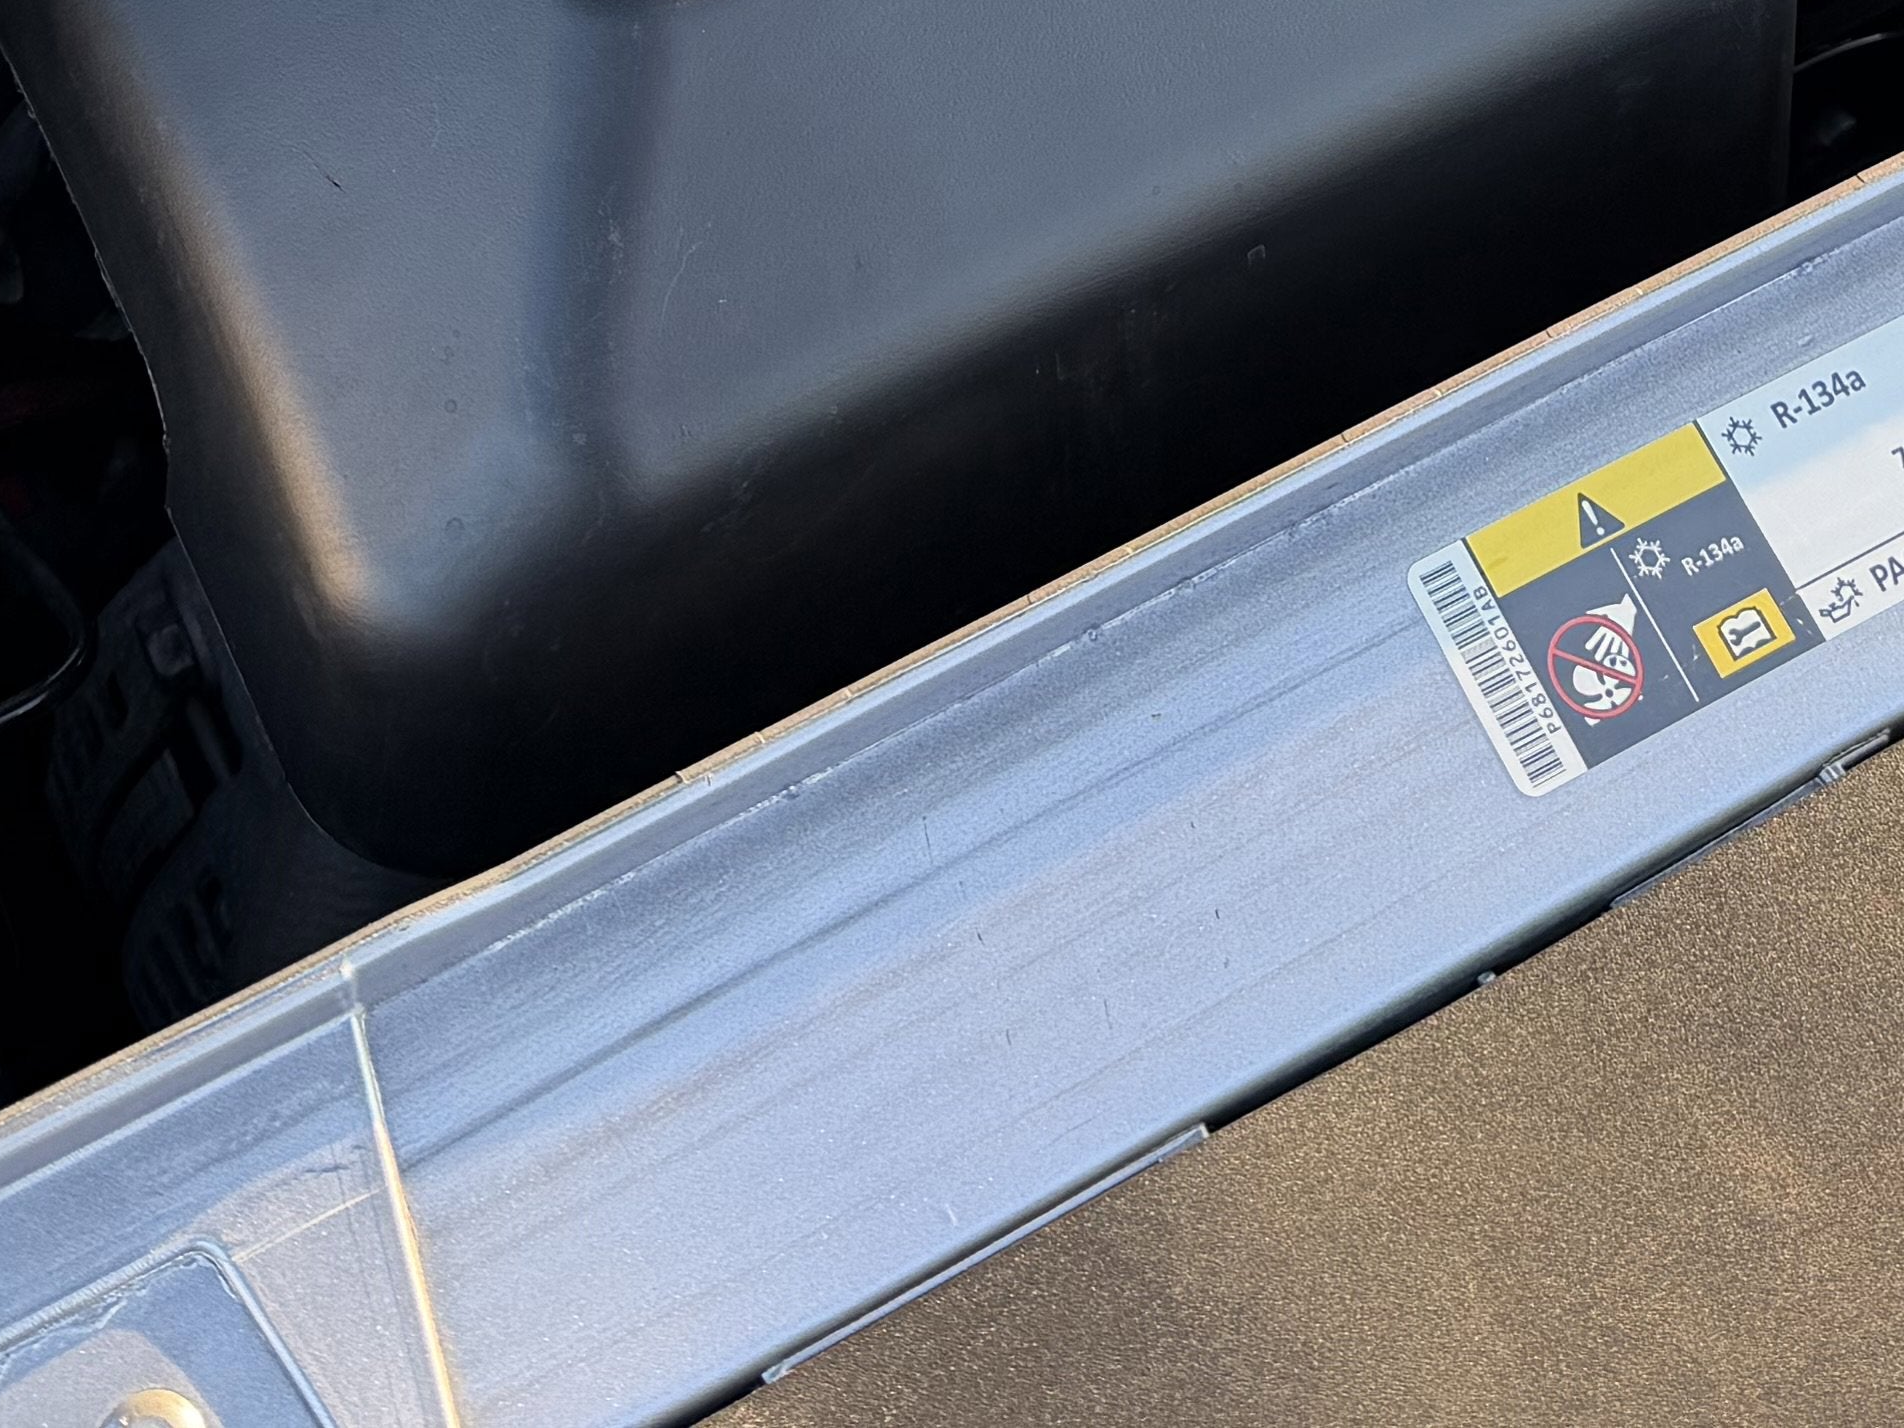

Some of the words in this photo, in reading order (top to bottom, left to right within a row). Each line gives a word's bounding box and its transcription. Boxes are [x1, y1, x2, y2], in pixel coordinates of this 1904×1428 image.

[1768, 369, 1867, 430] R-134a
[1680, 533, 1746, 577] R-134a
[1472, 584, 1563, 735] P68172601AB
